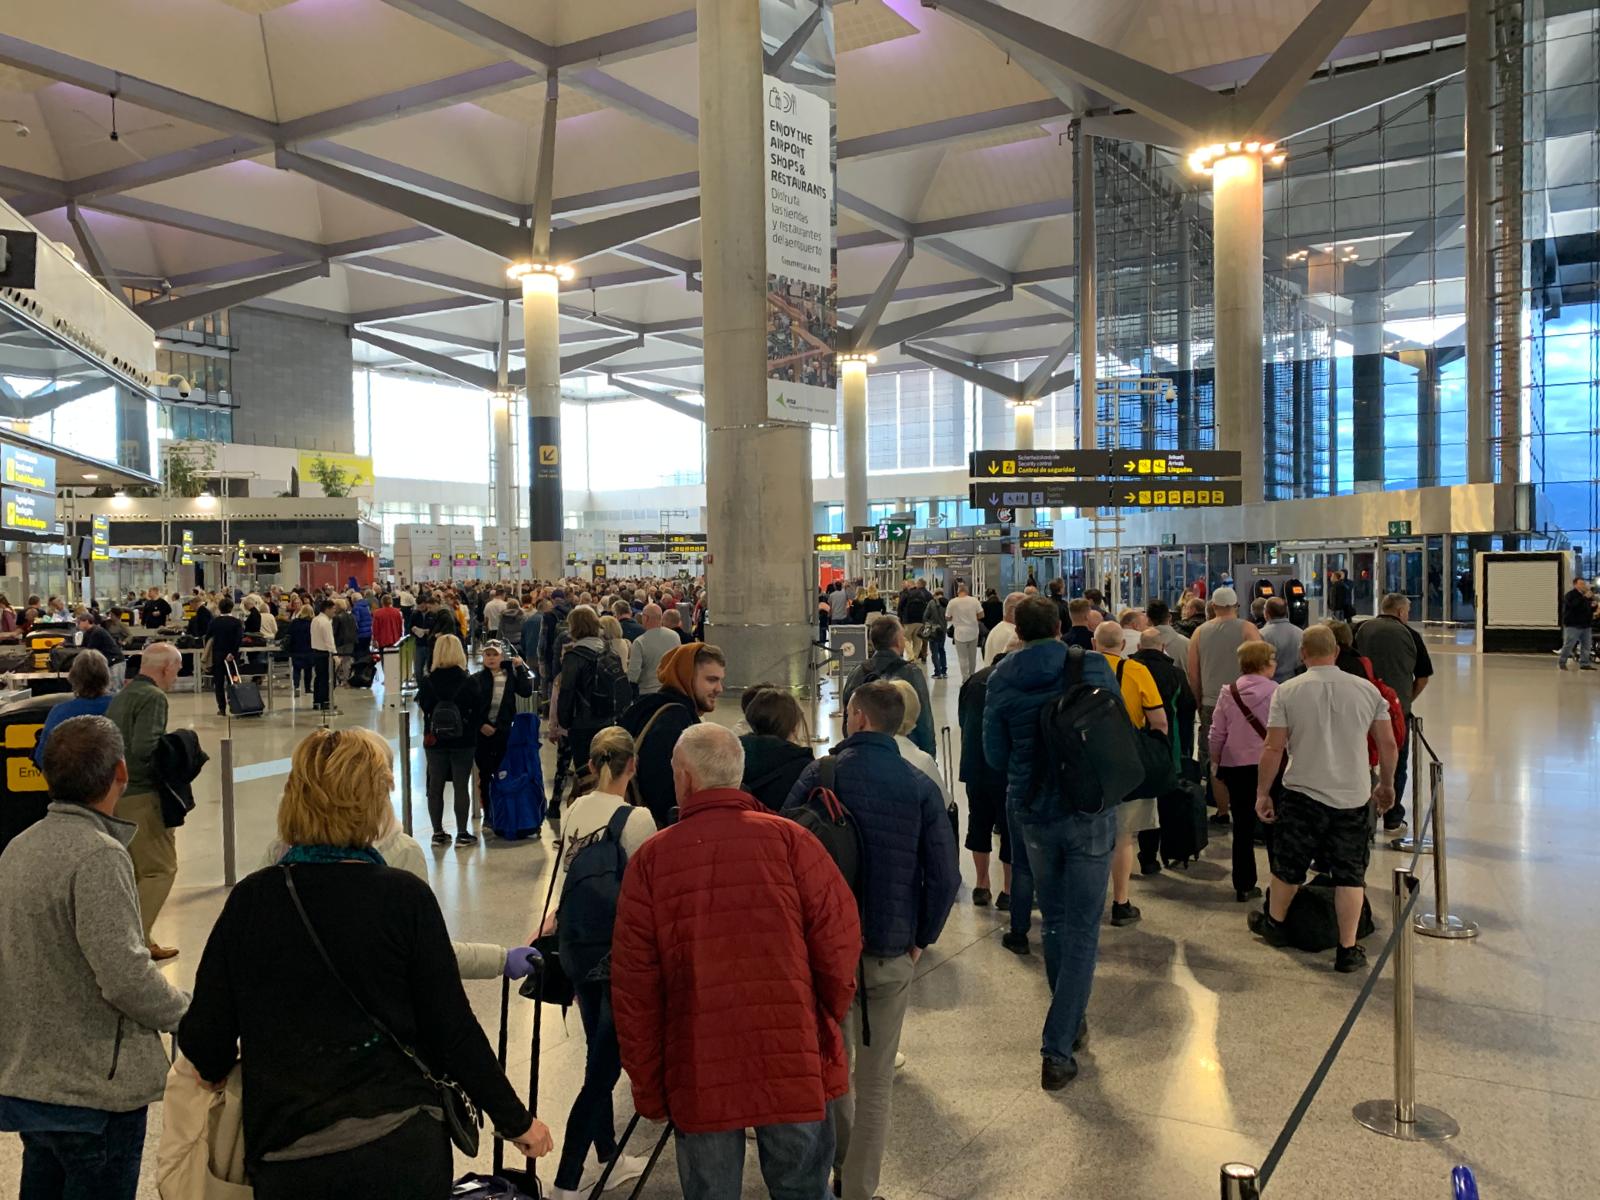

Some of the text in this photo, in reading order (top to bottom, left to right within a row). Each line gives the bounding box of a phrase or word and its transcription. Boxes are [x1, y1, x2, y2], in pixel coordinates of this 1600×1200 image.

[770, 120, 813, 145] ENJOY THE
[770, 137, 805, 159] AIRPORT
[771, 153, 806, 176] SHOPS &
[771, 170, 827, 199] RESTAURANTS
[771, 188, 800, 206] Disfruta
[771, 202, 783, 215] las
[772, 220, 822, 242] y restaurantes
[772, 234, 823, 256] del aeropuerto
[1047, 466, 1076, 474] seguridad
